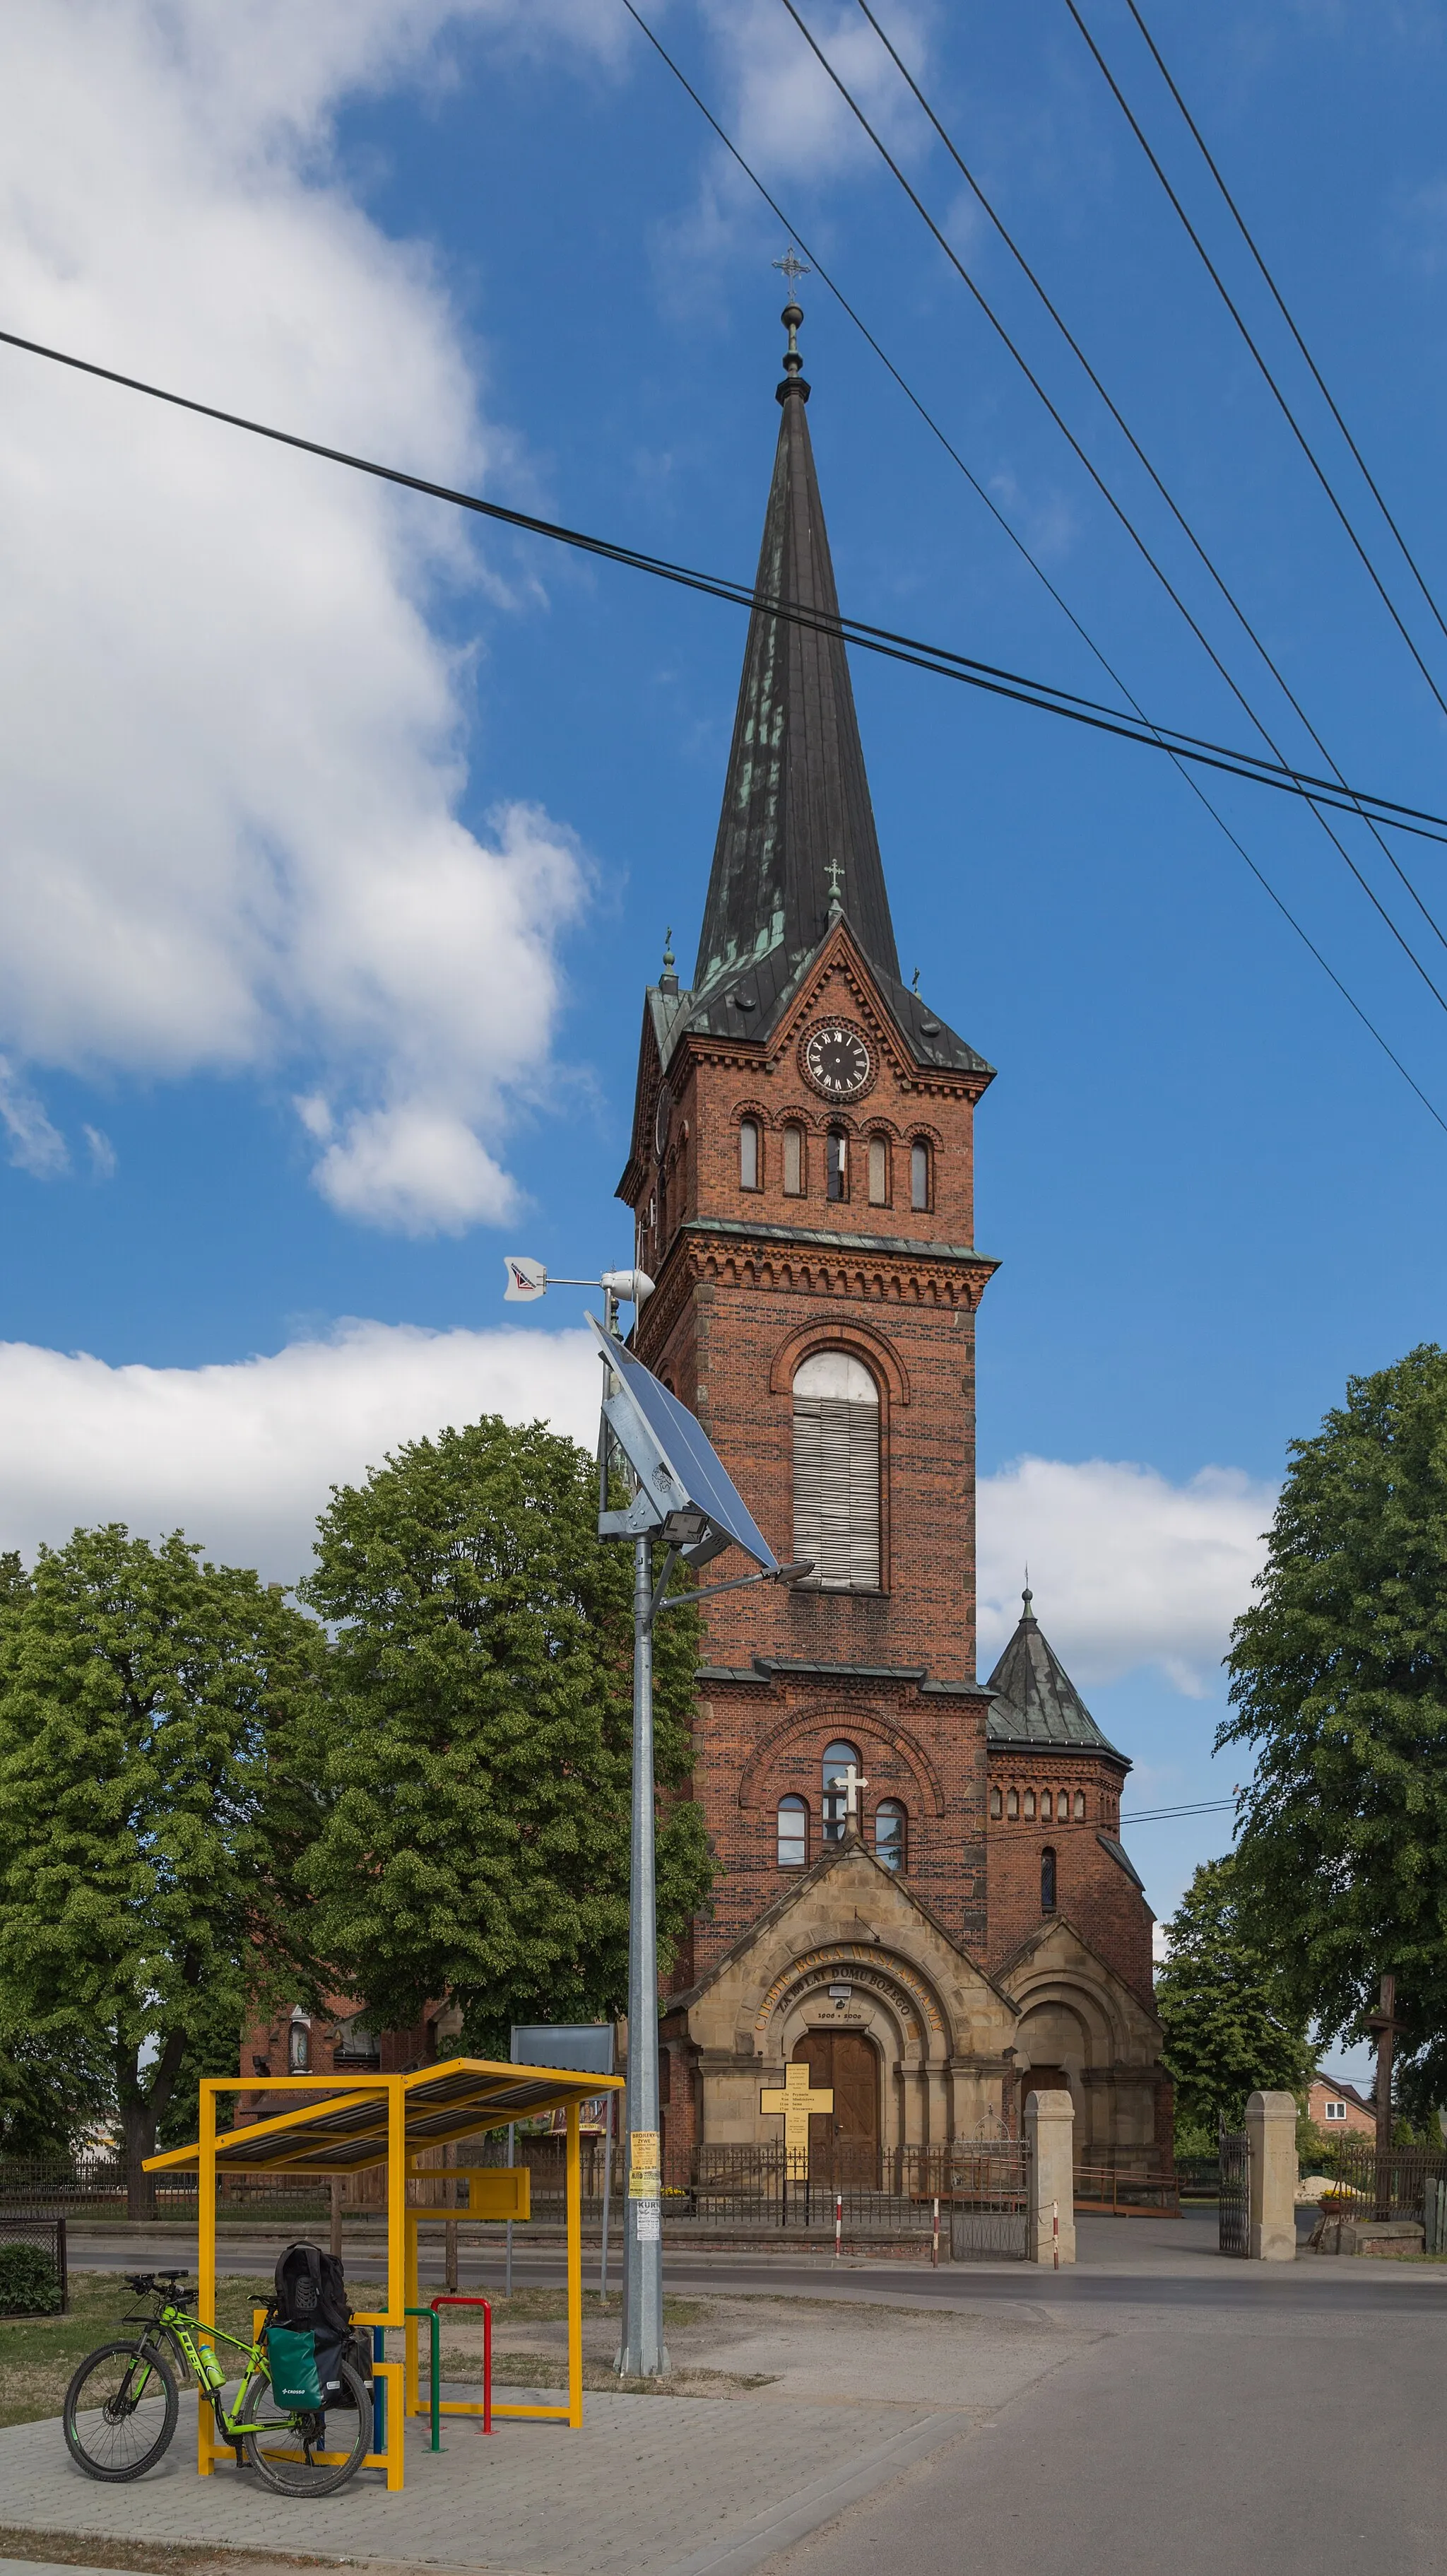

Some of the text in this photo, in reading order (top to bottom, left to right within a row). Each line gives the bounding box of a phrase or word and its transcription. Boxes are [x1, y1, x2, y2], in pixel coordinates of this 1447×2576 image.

[821, 1033, 831, 1045] XI
[846, 1036, 853, 1046] I
[813, 1042, 823, 1051] X
[834, 1079, 842, 1090] VI
[846, 1078, 854, 1088] V
[755, 1945, 944, 2032] CIEBIE BOGA WYSŁAWIAMY
[776, 1968, 910, 2016] ZA 100 LAT DOMU BOŻEGO
